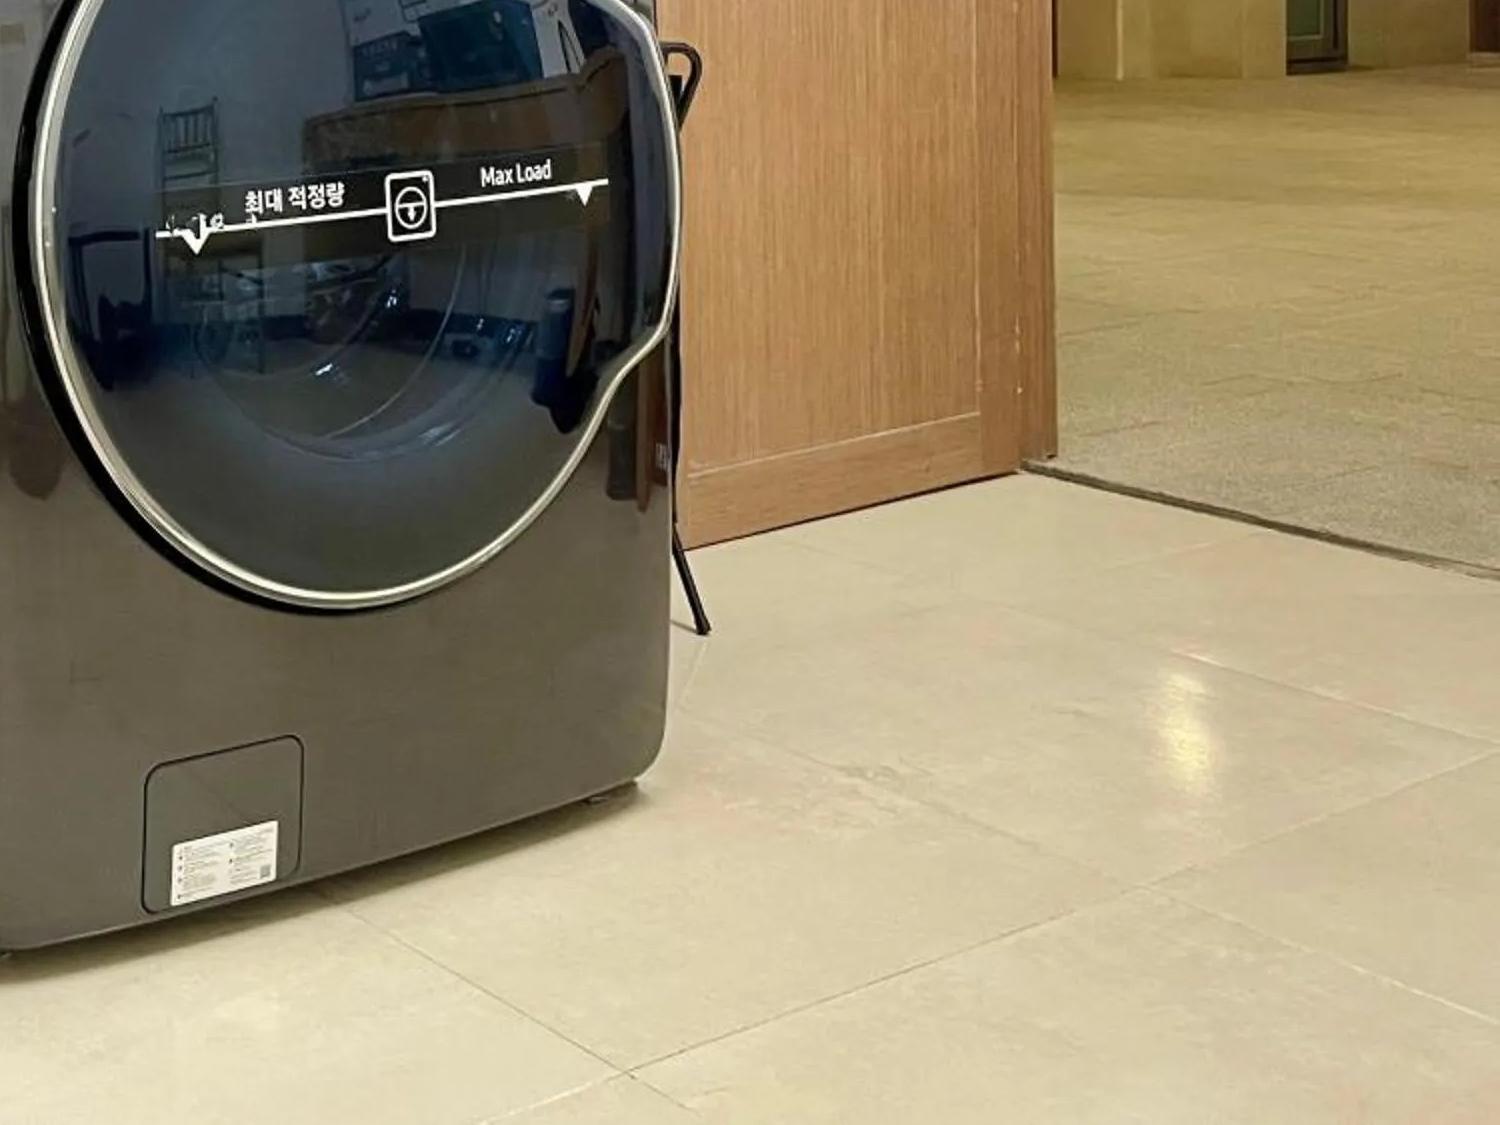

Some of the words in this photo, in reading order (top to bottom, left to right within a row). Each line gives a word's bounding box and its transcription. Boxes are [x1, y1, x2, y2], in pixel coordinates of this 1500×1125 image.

[480, 166, 515, 188] Max
[515, 158, 553, 184] Load
[245, 187, 283, 214] 최대
[288, 180, 345, 210] 적정량
